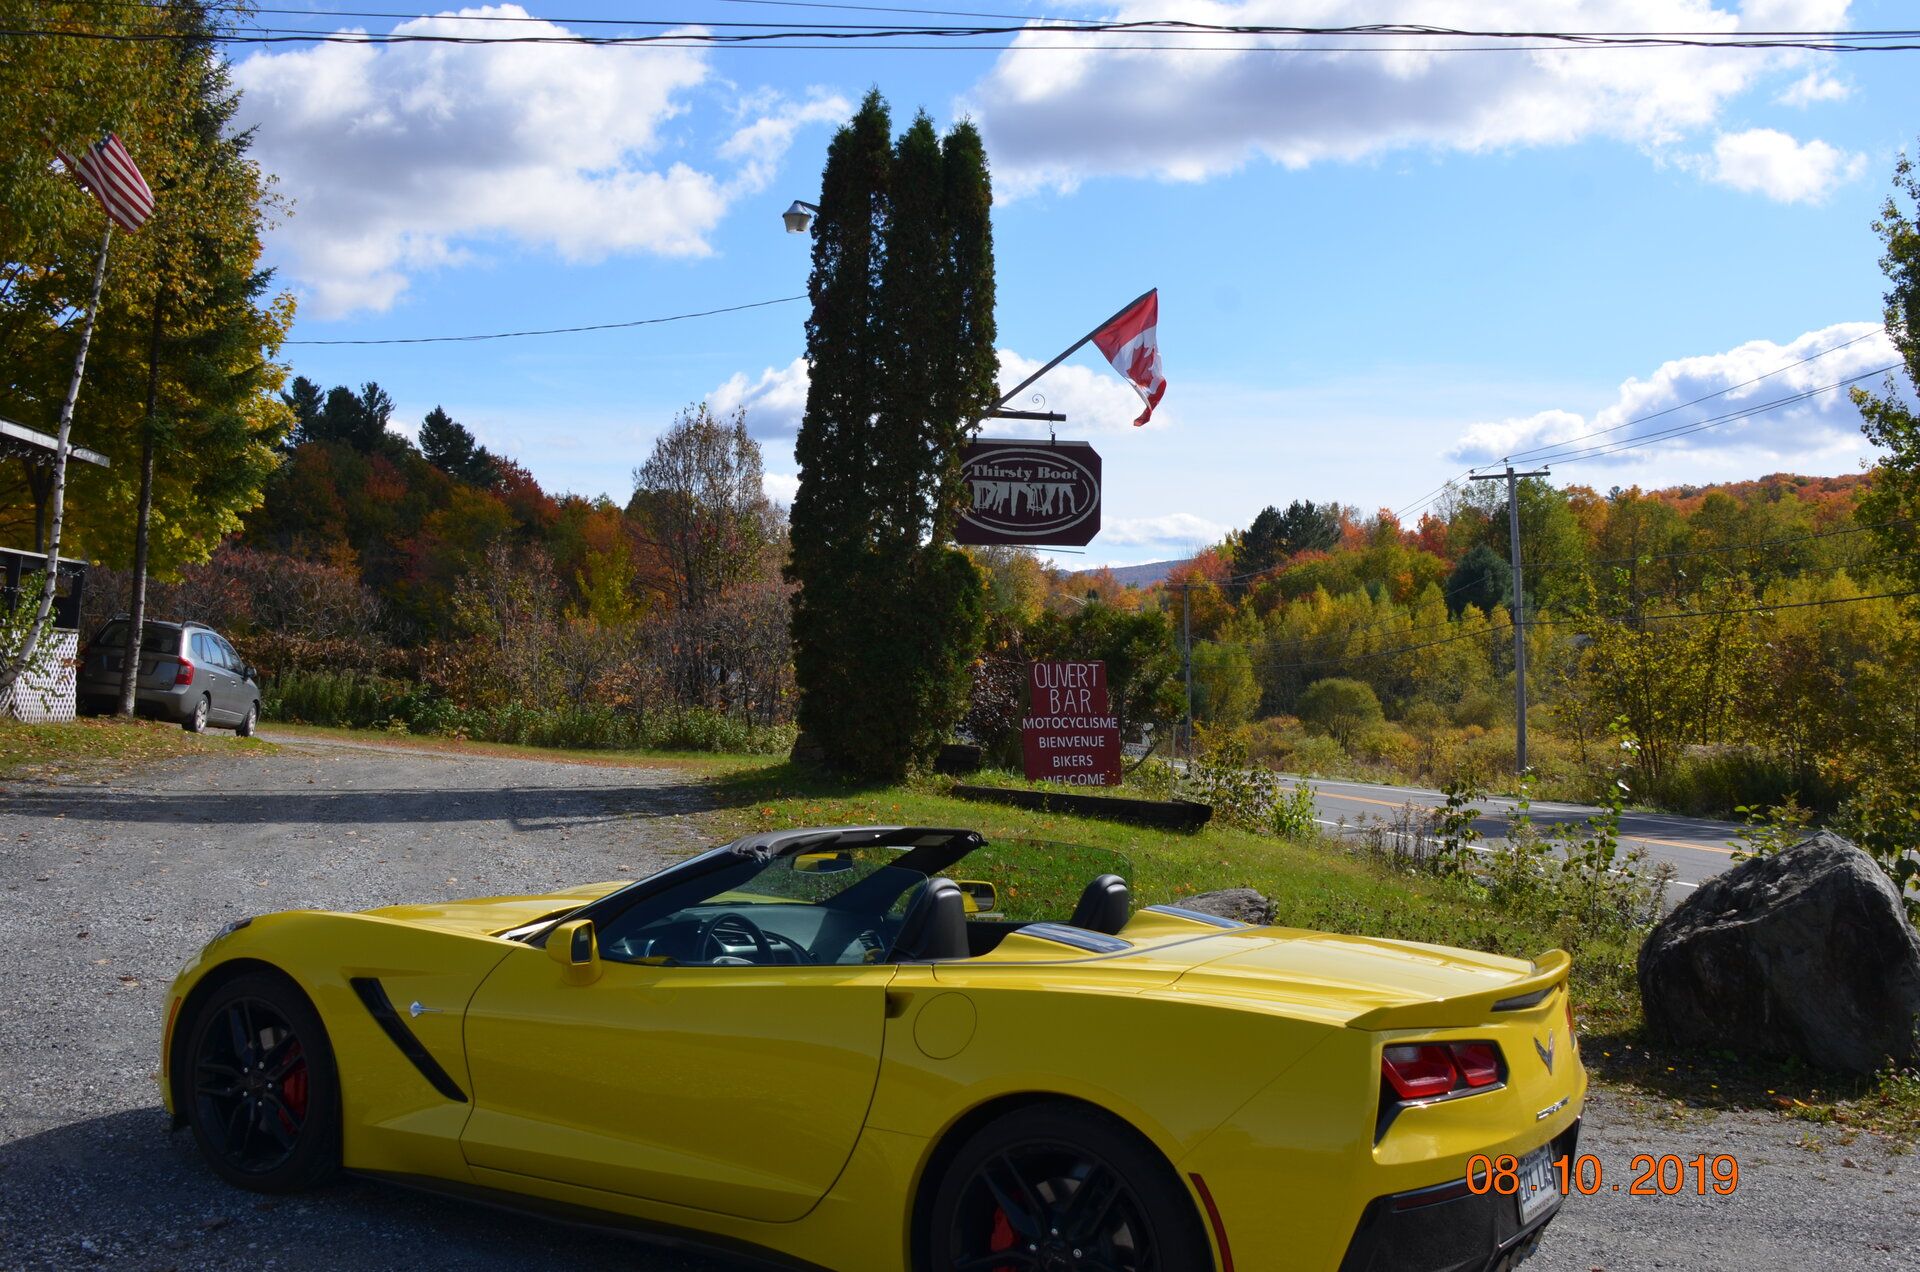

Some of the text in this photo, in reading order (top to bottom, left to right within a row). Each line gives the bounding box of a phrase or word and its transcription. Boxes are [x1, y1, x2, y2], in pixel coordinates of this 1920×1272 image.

[971, 464, 1079, 481] Thirsty Boot
[1034, 663, 1099, 688] OUVERT
[1050, 688, 1092, 714] BAR
[1022, 717, 1118, 729] MOTOCYCLISME
[1039, 735, 1105, 748] BIENVENUE
[1053, 755, 1093, 767] BIKERS
